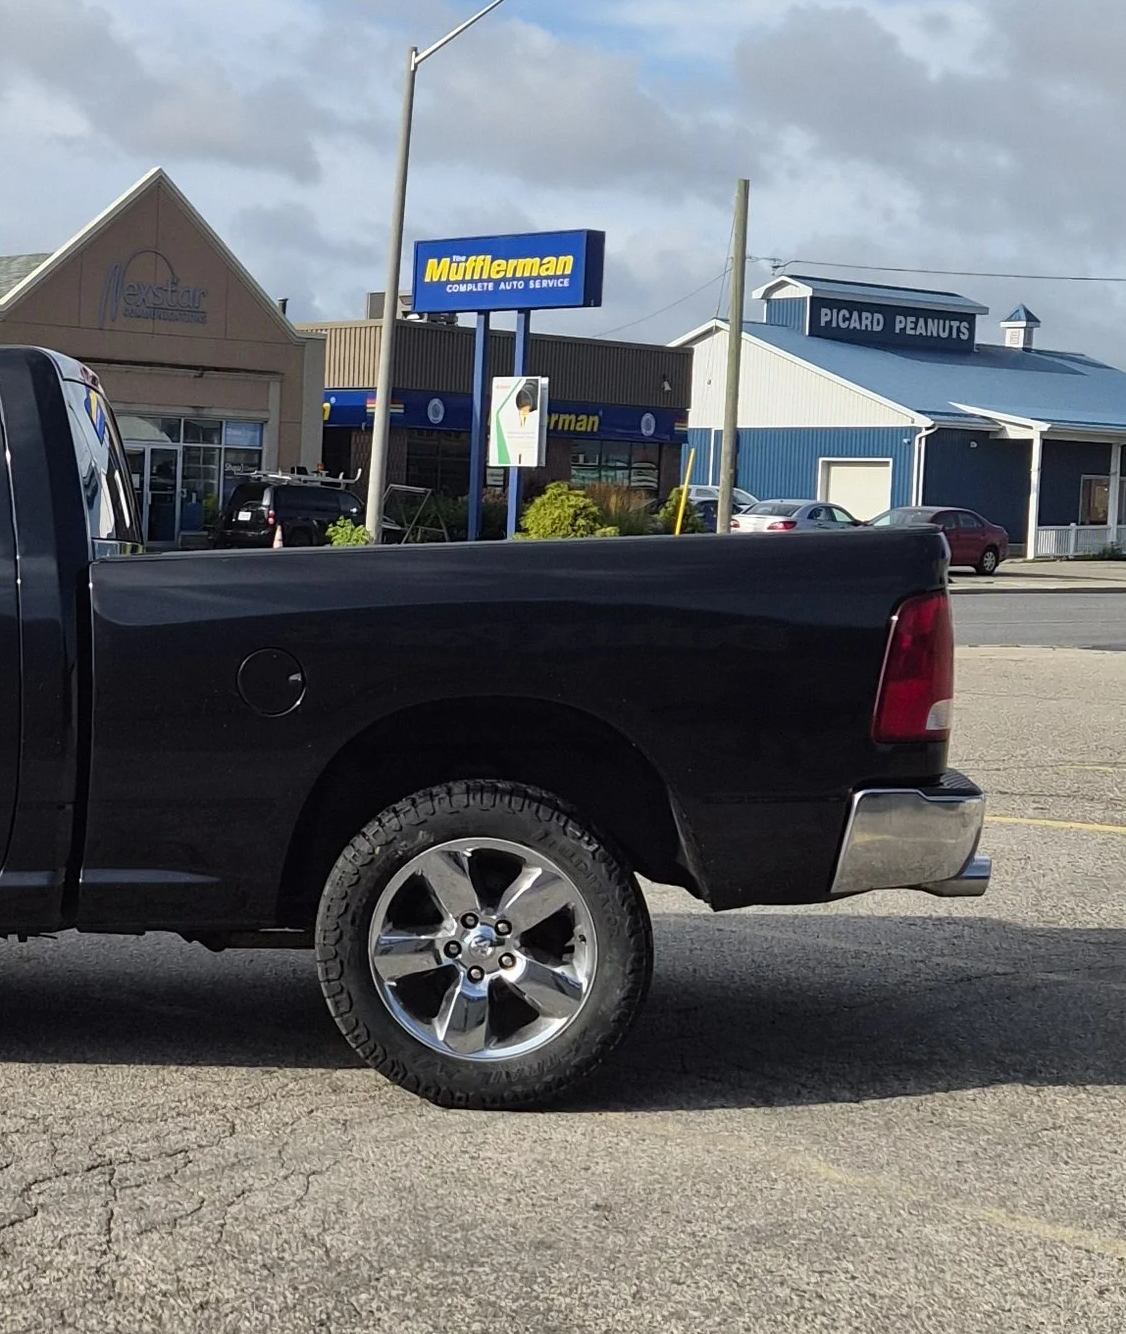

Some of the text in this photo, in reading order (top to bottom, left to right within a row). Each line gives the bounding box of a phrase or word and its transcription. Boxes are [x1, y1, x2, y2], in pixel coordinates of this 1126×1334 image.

[424, 255, 573, 282] Mufflerman
[446, 278, 570, 293] COMPLETE AUTO SERVICE
[820, 307, 970, 341] PICARD PEANUTS
